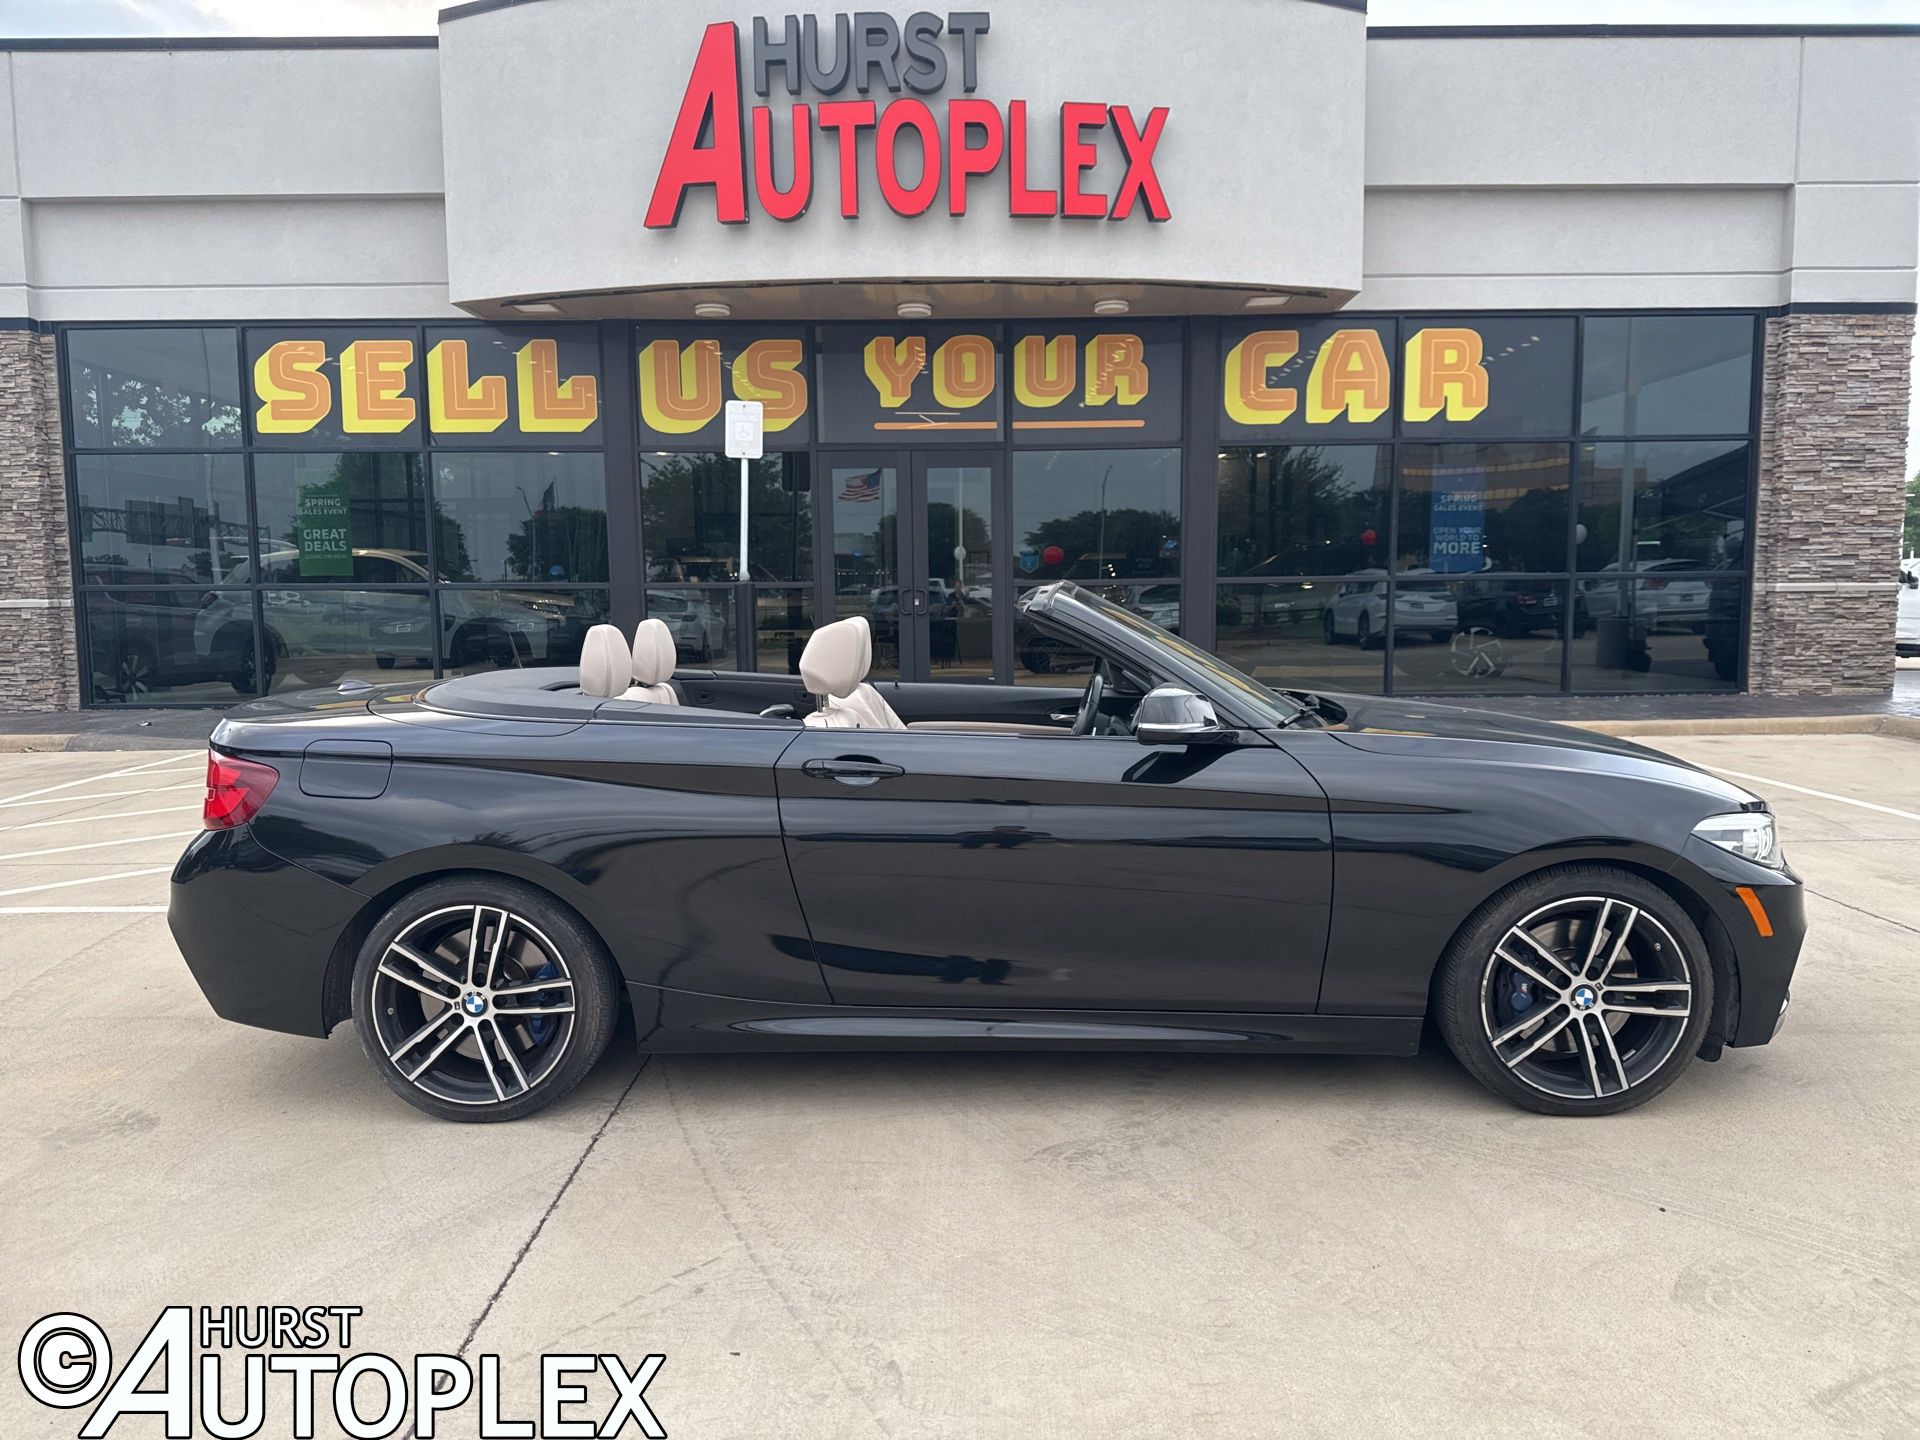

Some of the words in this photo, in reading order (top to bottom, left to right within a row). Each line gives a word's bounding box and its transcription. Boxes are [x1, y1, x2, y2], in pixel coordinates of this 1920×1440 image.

[753, 12, 990, 97] HURST
[643, 21, 1172, 229] AUTOPLEX
[254, 339, 598, 434] SELL
[639, 339, 807, 434] US
[864, 334, 1148, 408] YOUR
[1224, 328, 1489, 425] CAR
[304, 498, 340, 507] SPRING
[1440, 494, 1477, 503] SPRING
[303, 528, 346, 540] GREAT
[304, 540, 347, 551] DEALS
[1433, 541, 1480, 554] MORE
